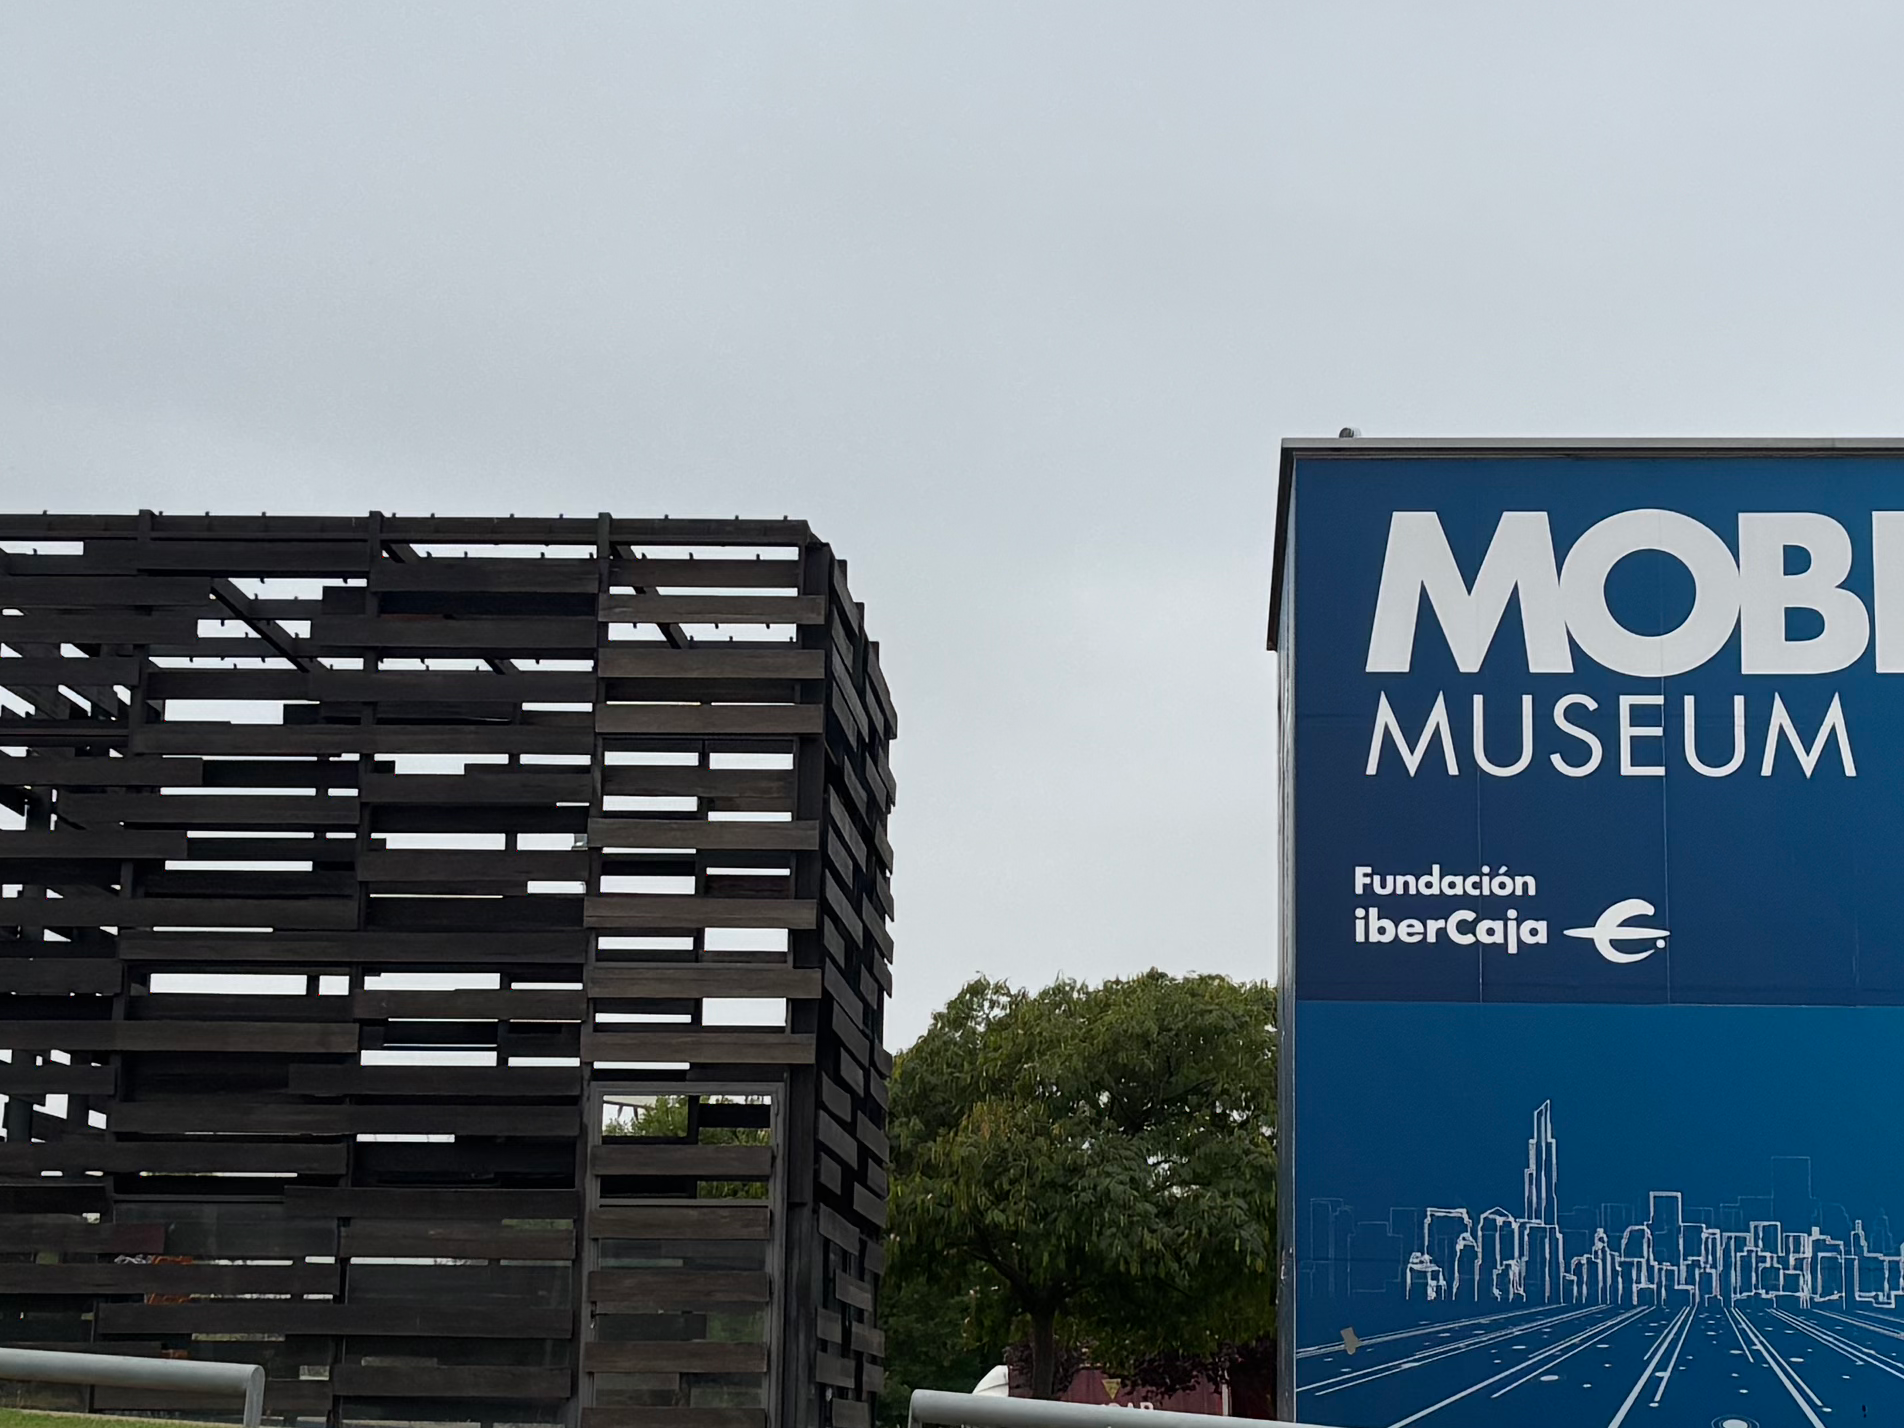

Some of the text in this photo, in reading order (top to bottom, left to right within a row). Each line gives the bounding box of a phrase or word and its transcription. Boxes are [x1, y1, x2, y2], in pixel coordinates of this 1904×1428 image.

[1365, 690, 1857, 779] MUSEUM
[1354, 864, 1536, 896] Fundación
[1354, 907, 1548, 954] iberCaja
